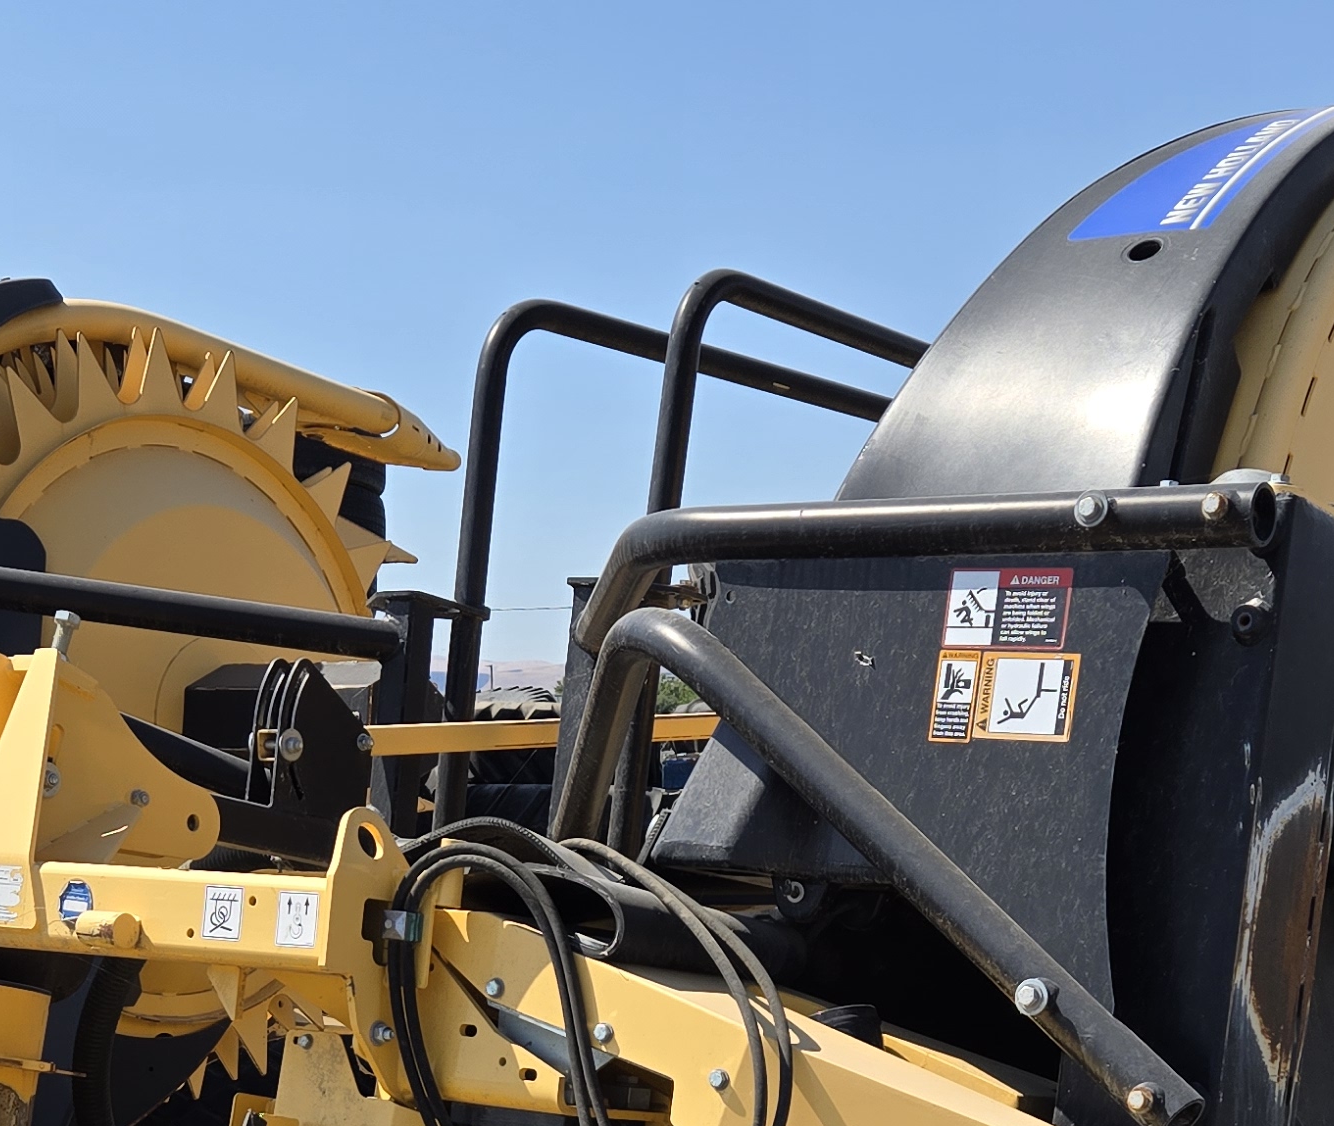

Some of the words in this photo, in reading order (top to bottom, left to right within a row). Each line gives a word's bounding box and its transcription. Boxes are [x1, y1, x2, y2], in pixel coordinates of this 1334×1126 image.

[1159, 182, 1223, 226] NEW
[1202, 119, 1301, 180] HOLLAND
[1021, 575, 1060, 585] DANGER
[980, 658, 995, 714] WARNING
[1062, 675, 1070, 691] ride
[1060, 691, 1068, 706] not
[1057, 707, 1066, 719] Do
